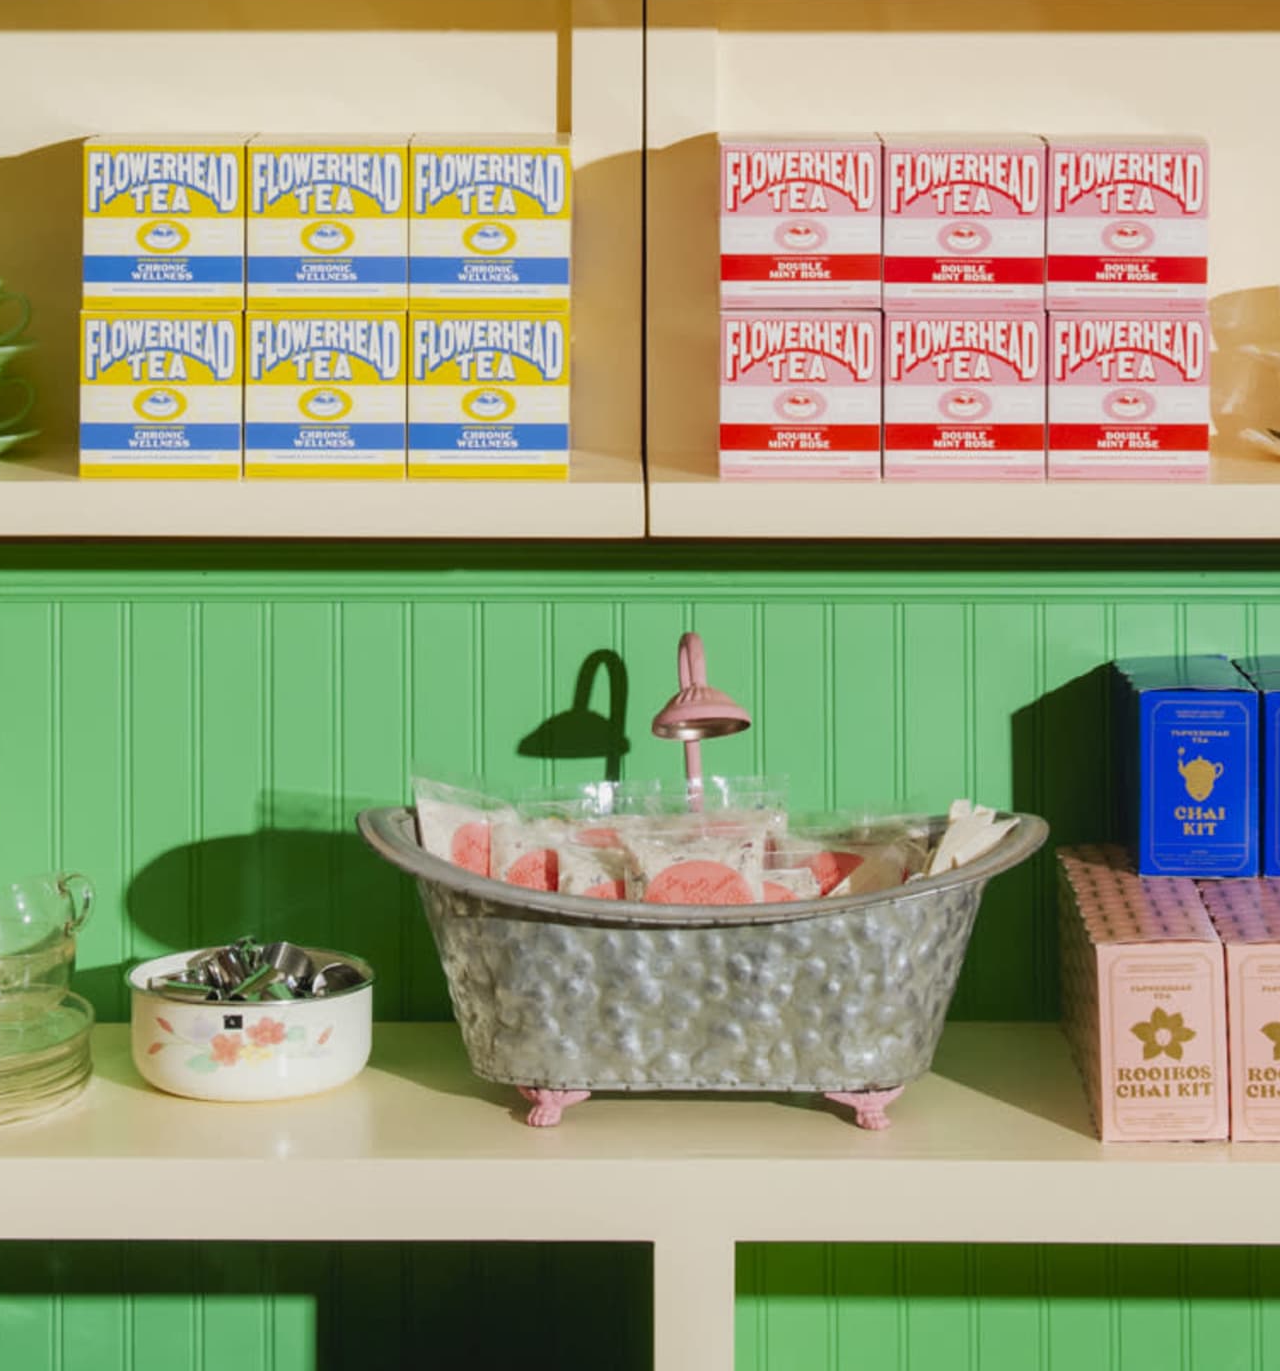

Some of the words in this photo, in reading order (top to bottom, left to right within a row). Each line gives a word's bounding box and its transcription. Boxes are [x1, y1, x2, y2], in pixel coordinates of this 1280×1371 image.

[88, 152, 238, 213] FLOWERHEAD
[252, 153, 402, 214] FLOWERHEAD
[414, 153, 564, 214] FLOWERHEAD
[726, 151, 875, 212] FLOWERHEAD
[890, 153, 1039, 214] FLOWERHEAD
[1054, 153, 1203, 214] FLOWERHEAD
[131, 183, 190, 213] TEA
[295, 184, 354, 214] TEA
[457, 184, 516, 214] TEA
[769, 183, 828, 212] TEA
[933, 185, 992, 214] TEA
[1097, 185, 1156, 214] TEA
[136, 263, 188, 272] CHRONIC
[300, 264, 352, 273] CHRONIC
[462, 264, 514, 273] CHRONIC
[777, 261, 822, 270] DOUBLE
[940, 264, 985, 273] DOUBLE
[1104, 263, 1149, 272] DOUBLE
[131, 271, 193, 281] WELLNESS
[295, 272, 357, 282] WELLNESS
[457, 272, 519, 282] WELLNESS
[768, 270, 796, 279] MINT
[800, 270, 832, 279] ROSE
[931, 273, 959, 282] MINT
[963, 273, 995, 282] ROSE
[1095, 272, 1123, 281] MINT
[1127, 272, 1159, 281] ROSE
[85, 319, 235, 380] FLOWERHEAD
[250, 319, 400, 380] FLOWERHEAD
[413, 320, 563, 381] FLOWERHEAD
[726, 321, 875, 382] FLOWERHEAD
[890, 320, 1039, 381] FLOWERHEAD
[1055, 320, 1204, 381] FLOWERHEAD
[128, 350, 187, 380] TEA
[293, 350, 352, 380] TEA
[456, 351, 515, 381] TEA
[769, 353, 828, 382] TEA
[933, 352, 992, 381] TEA
[1098, 352, 1157, 381] TEA
[133, 430, 185, 439] CHRONIC
[298, 430, 350, 439] CHRONIC
[461, 431, 513, 440] CHRONIC
[776, 431, 821, 440] DOUBLE
[941, 430, 986, 439] DOUBLE
[1105, 431, 1150, 440] DOUBLE
[128, 438, 190, 448] WELLNESS
[293, 438, 355, 448] WELLNESS
[456, 439, 518, 449] WELLNESS
[767, 440, 795, 449] MINT
[799, 440, 831, 449] ROSE
[932, 439, 960, 448] MINT
[964, 439, 996, 448] ROSE
[1096, 440, 1124, 449] MINT
[1128, 440, 1160, 449] ROSE
[1174, 807, 1226, 820] CHAI
[1183, 823, 1217, 836] KIT
[1117, 1066, 1212, 1081] ROOIBOS
[1116, 1083, 1172, 1099] CHAI
[1177, 1082, 1214, 1098] KIT
